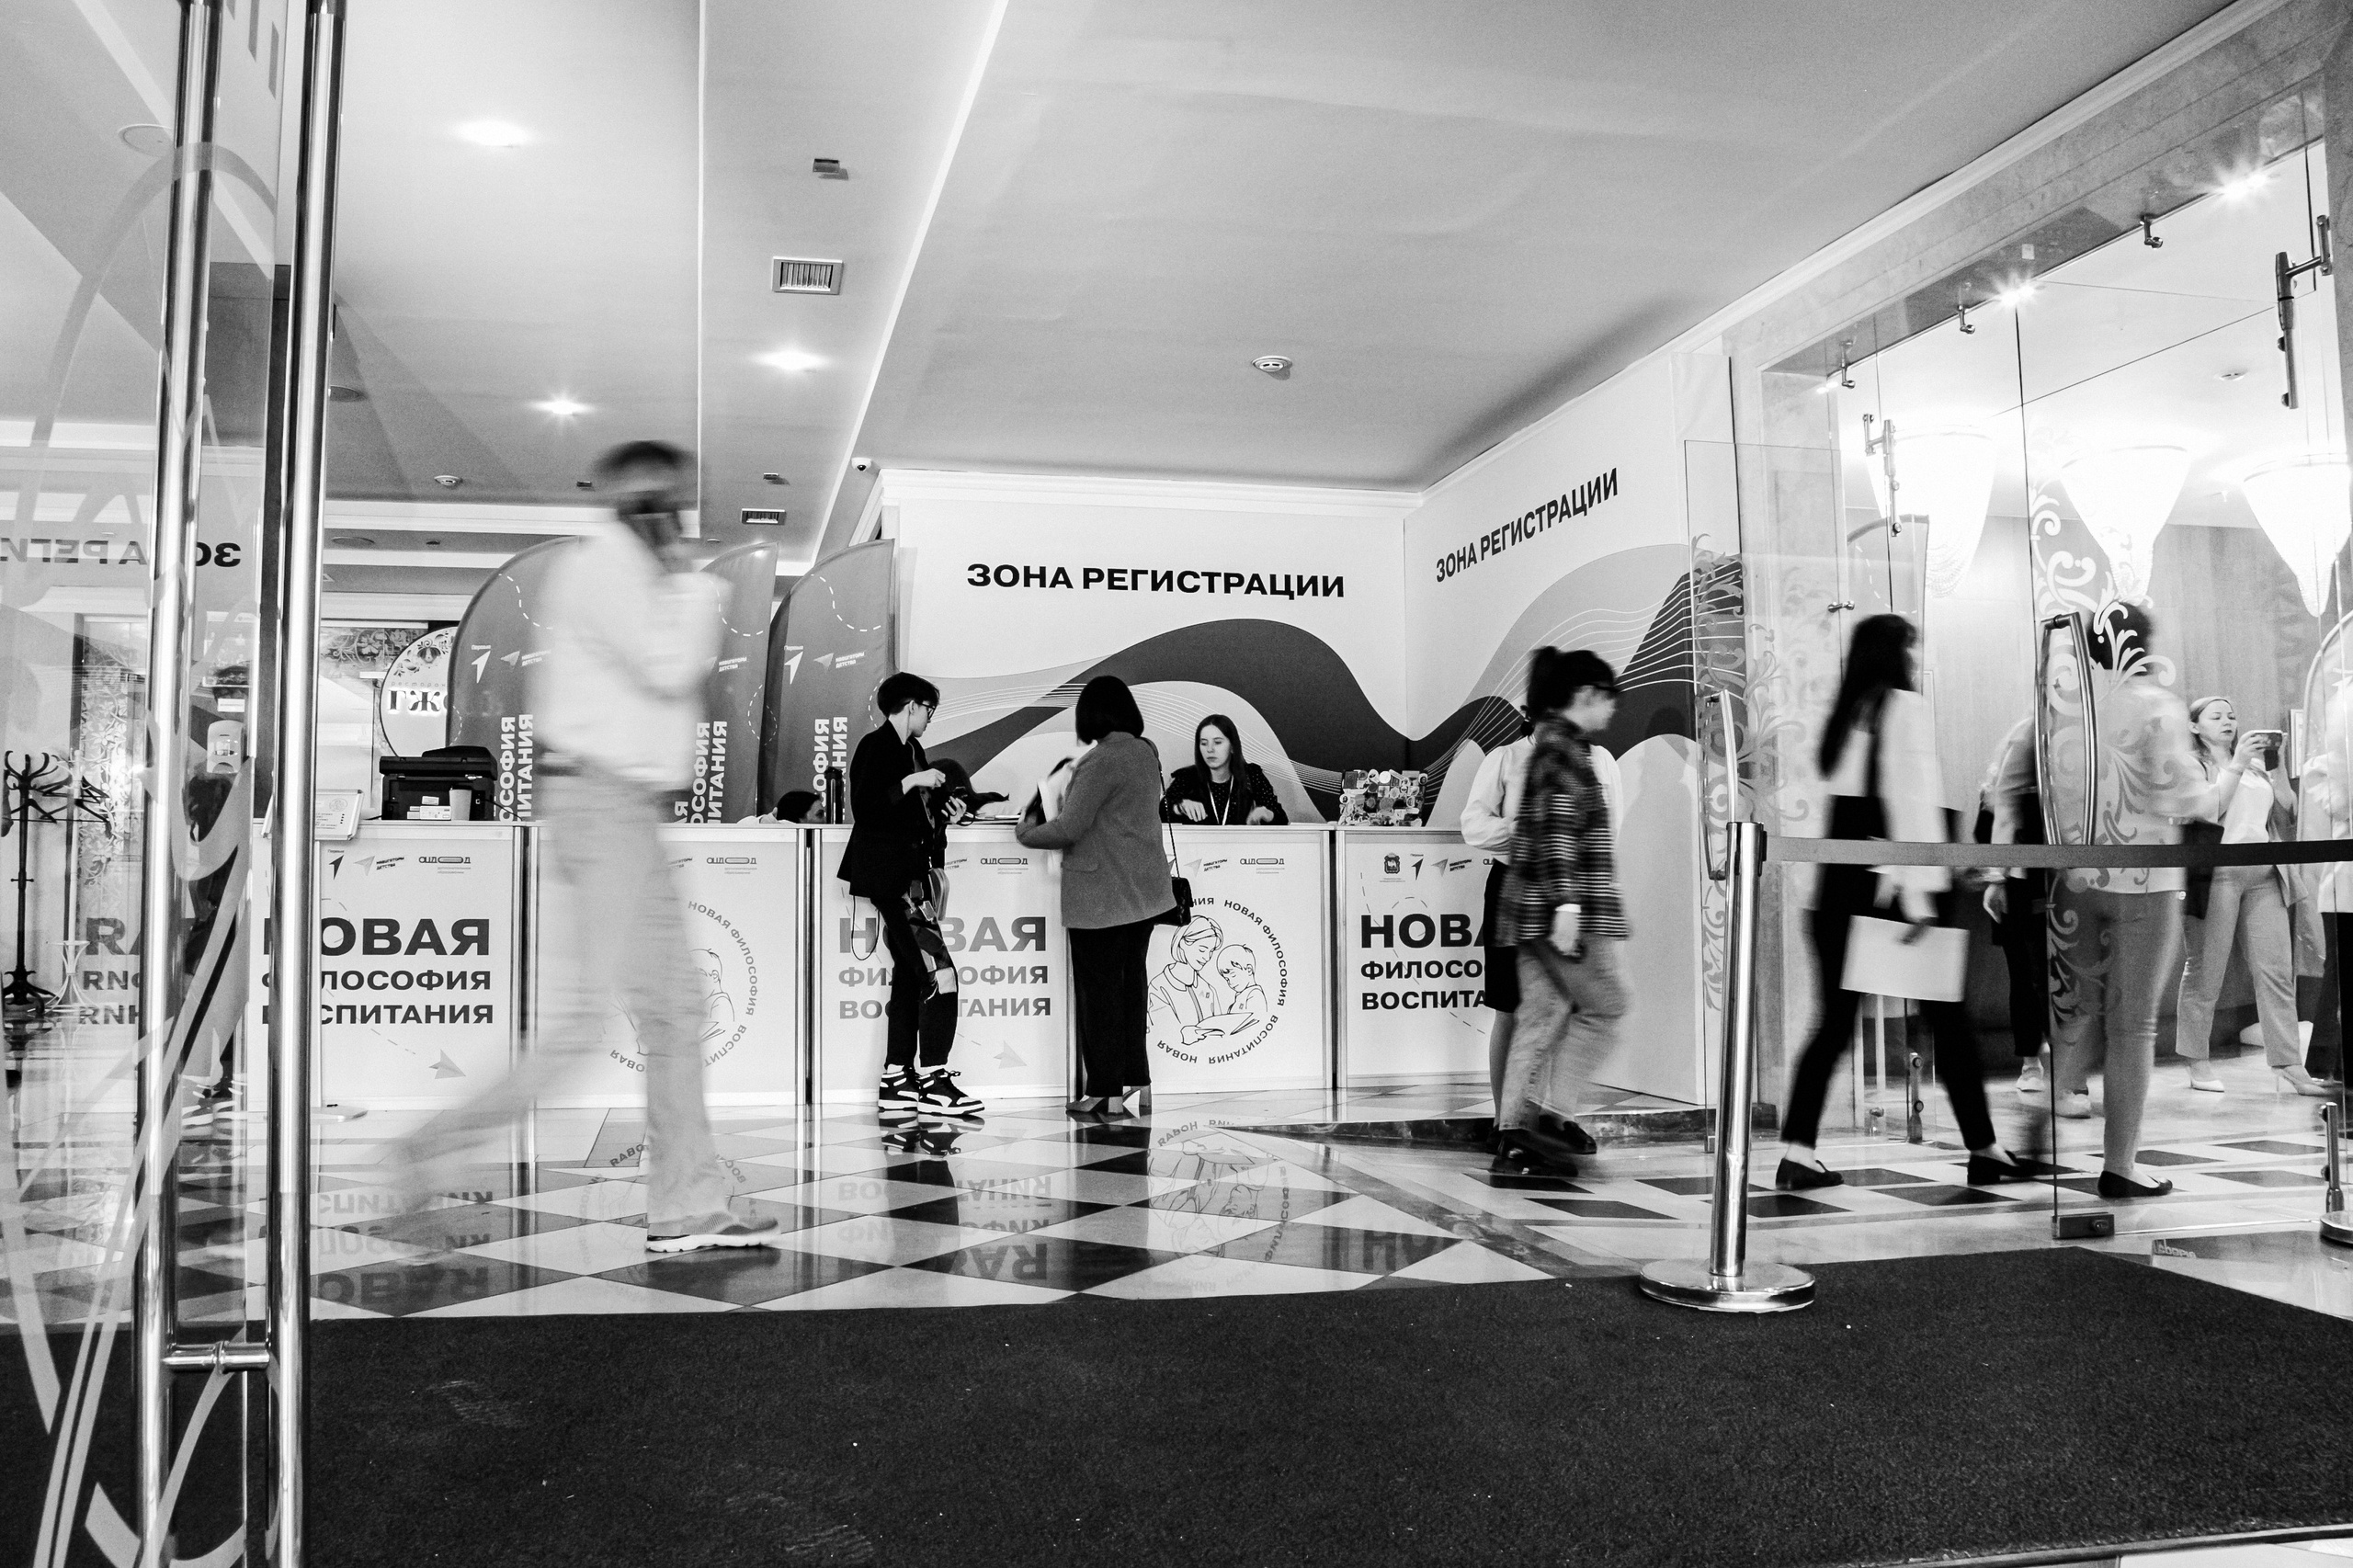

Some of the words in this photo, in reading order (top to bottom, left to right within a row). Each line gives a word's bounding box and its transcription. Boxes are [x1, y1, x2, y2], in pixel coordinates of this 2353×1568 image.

[1437, 542, 1477, 583] ЗОНА
[1481, 467, 1618, 562] РЕГИСТРАЦИИ
[967, 563, 1074, 589] ЗОНА
[1083, 568, 1345, 600] РЕГИСТРАЦИИ
[387, 689, 448, 712] ГЖ
[1224, 899, 1263, 926] НОВАЯ
[265, 917, 490, 956] ОВАЯ
[839, 916, 1046, 953] НВАЯ
[688, 901, 731, 929] НОВАЯ
[731, 928, 758, 1016] ФИЛОСОФИЯ
[838, 965, 1048, 987] ФИОФИЯ
[1262, 925, 1289, 1006] ФИЛОСОФИЯ
[262, 969, 492, 991] ЛОСОФИЯ
[262, 1005, 494, 1024] СПИТАНИЯ
[1156, 1040, 1198, 1063] НОВАЯ
[1208, 1015, 1279, 1064] ВОСПИТАНИЯ
